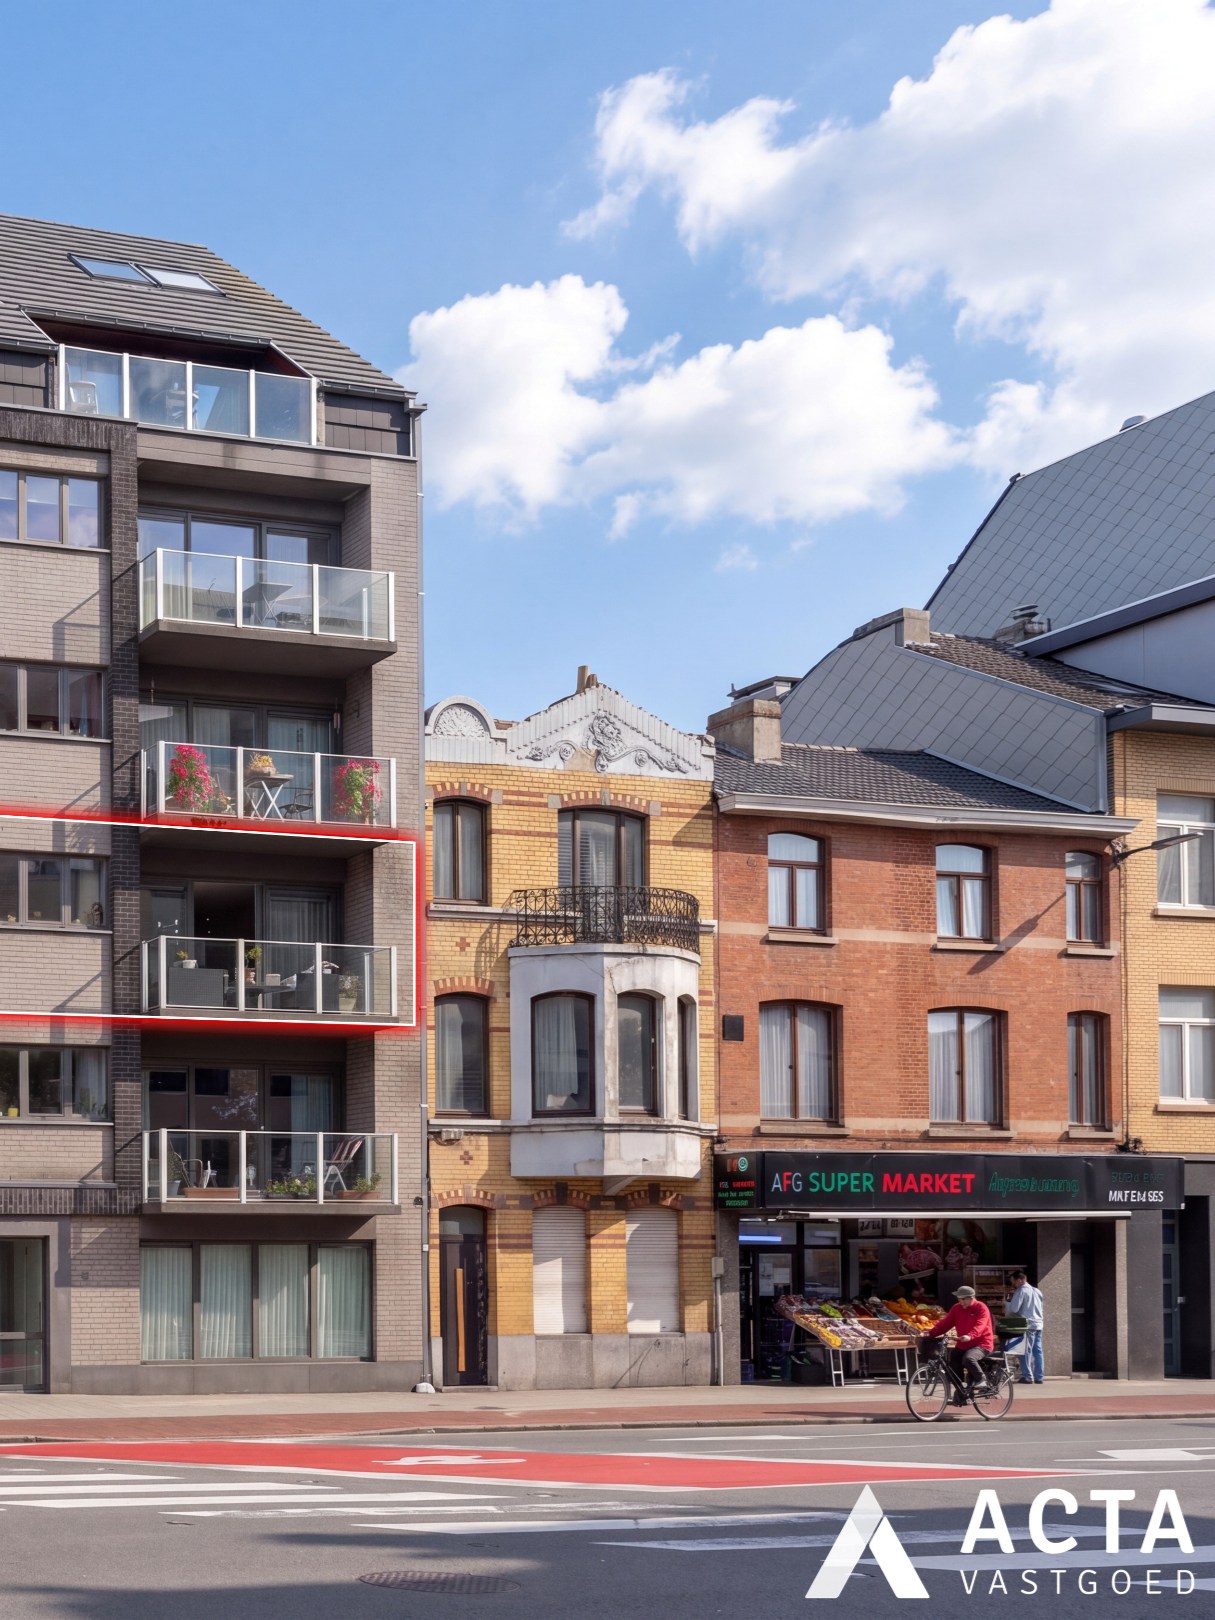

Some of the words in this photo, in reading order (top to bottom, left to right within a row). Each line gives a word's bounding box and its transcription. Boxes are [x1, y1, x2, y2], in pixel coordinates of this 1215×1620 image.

[771, 1172, 803, 1193] AFG
[808, 1172, 875, 1193] SUPER
[882, 1172, 975, 1194] MARKET
